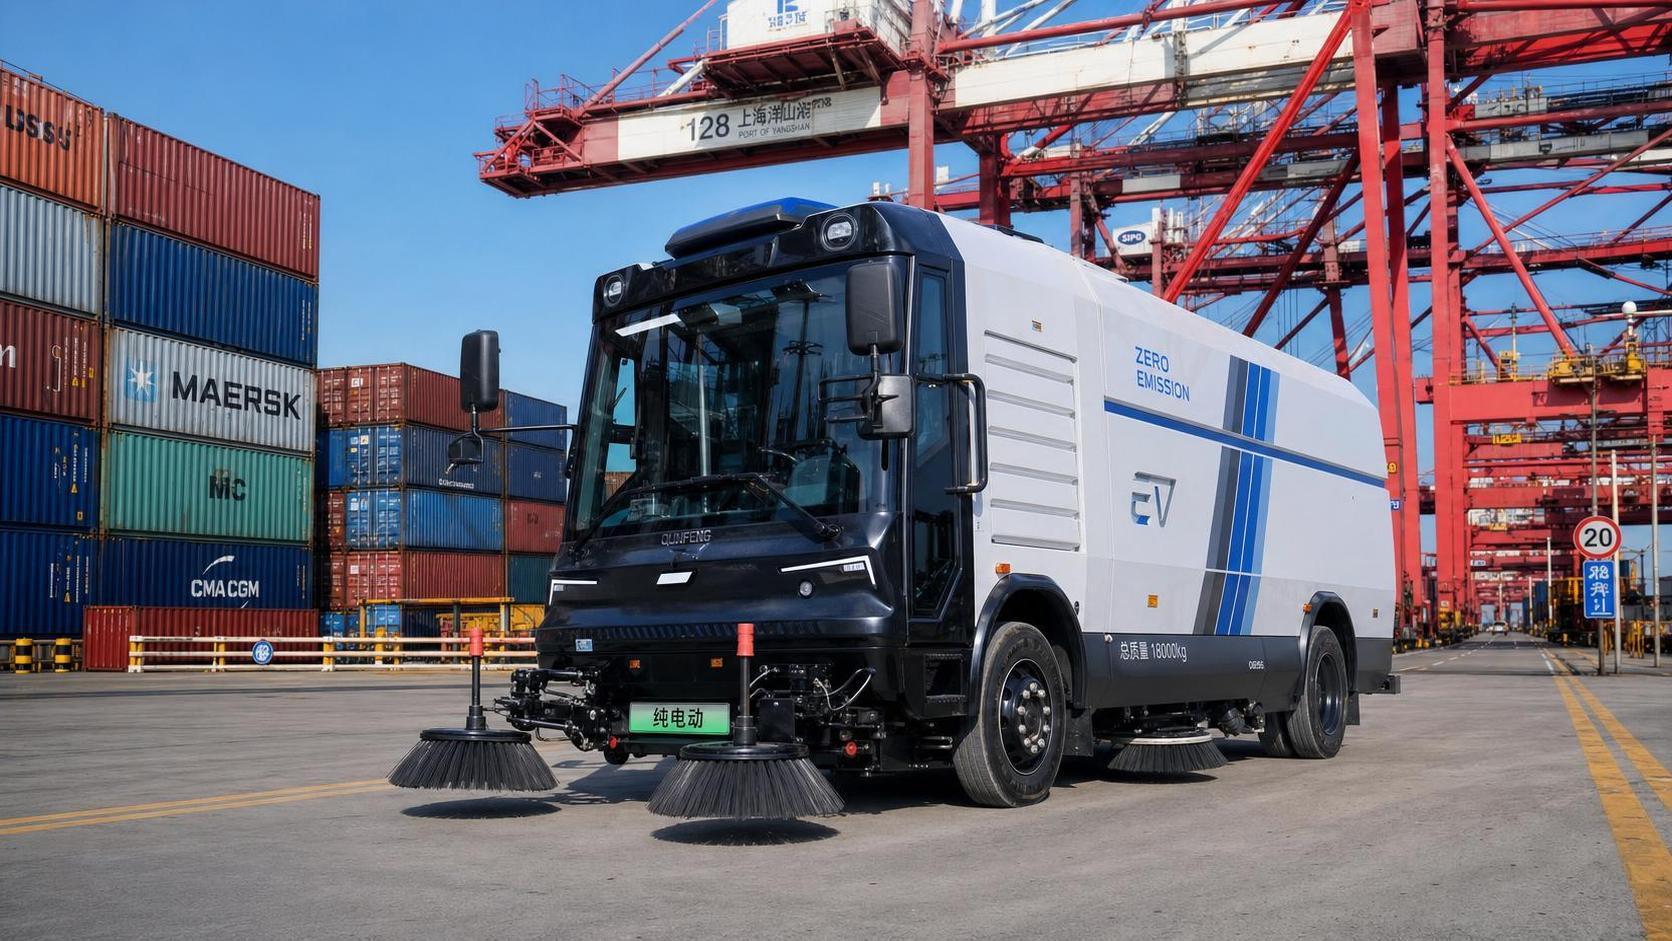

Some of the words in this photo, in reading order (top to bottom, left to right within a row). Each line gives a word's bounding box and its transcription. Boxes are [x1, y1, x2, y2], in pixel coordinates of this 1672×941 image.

[686, 113, 730, 142] 128
[738, 129, 758, 138] PORT
[760, 127, 769, 135] OF
[1122, 233, 1142, 243] SIPG
[1135, 346, 1169, 373] ZERO
[172, 371, 301, 421] MAERSK
[1137, 369, 1190, 401] EMISSION
[1130, 472, 1177, 528] EV
[1584, 527, 1613, 547] 20
[191, 579, 226, 598] CMA
[227, 580, 259, 598] CGM
[1120, 641, 1149, 660] 总质量
[1151, 642, 1188, 663] 18000kg
[653, 708, 704, 729] 纯电动
